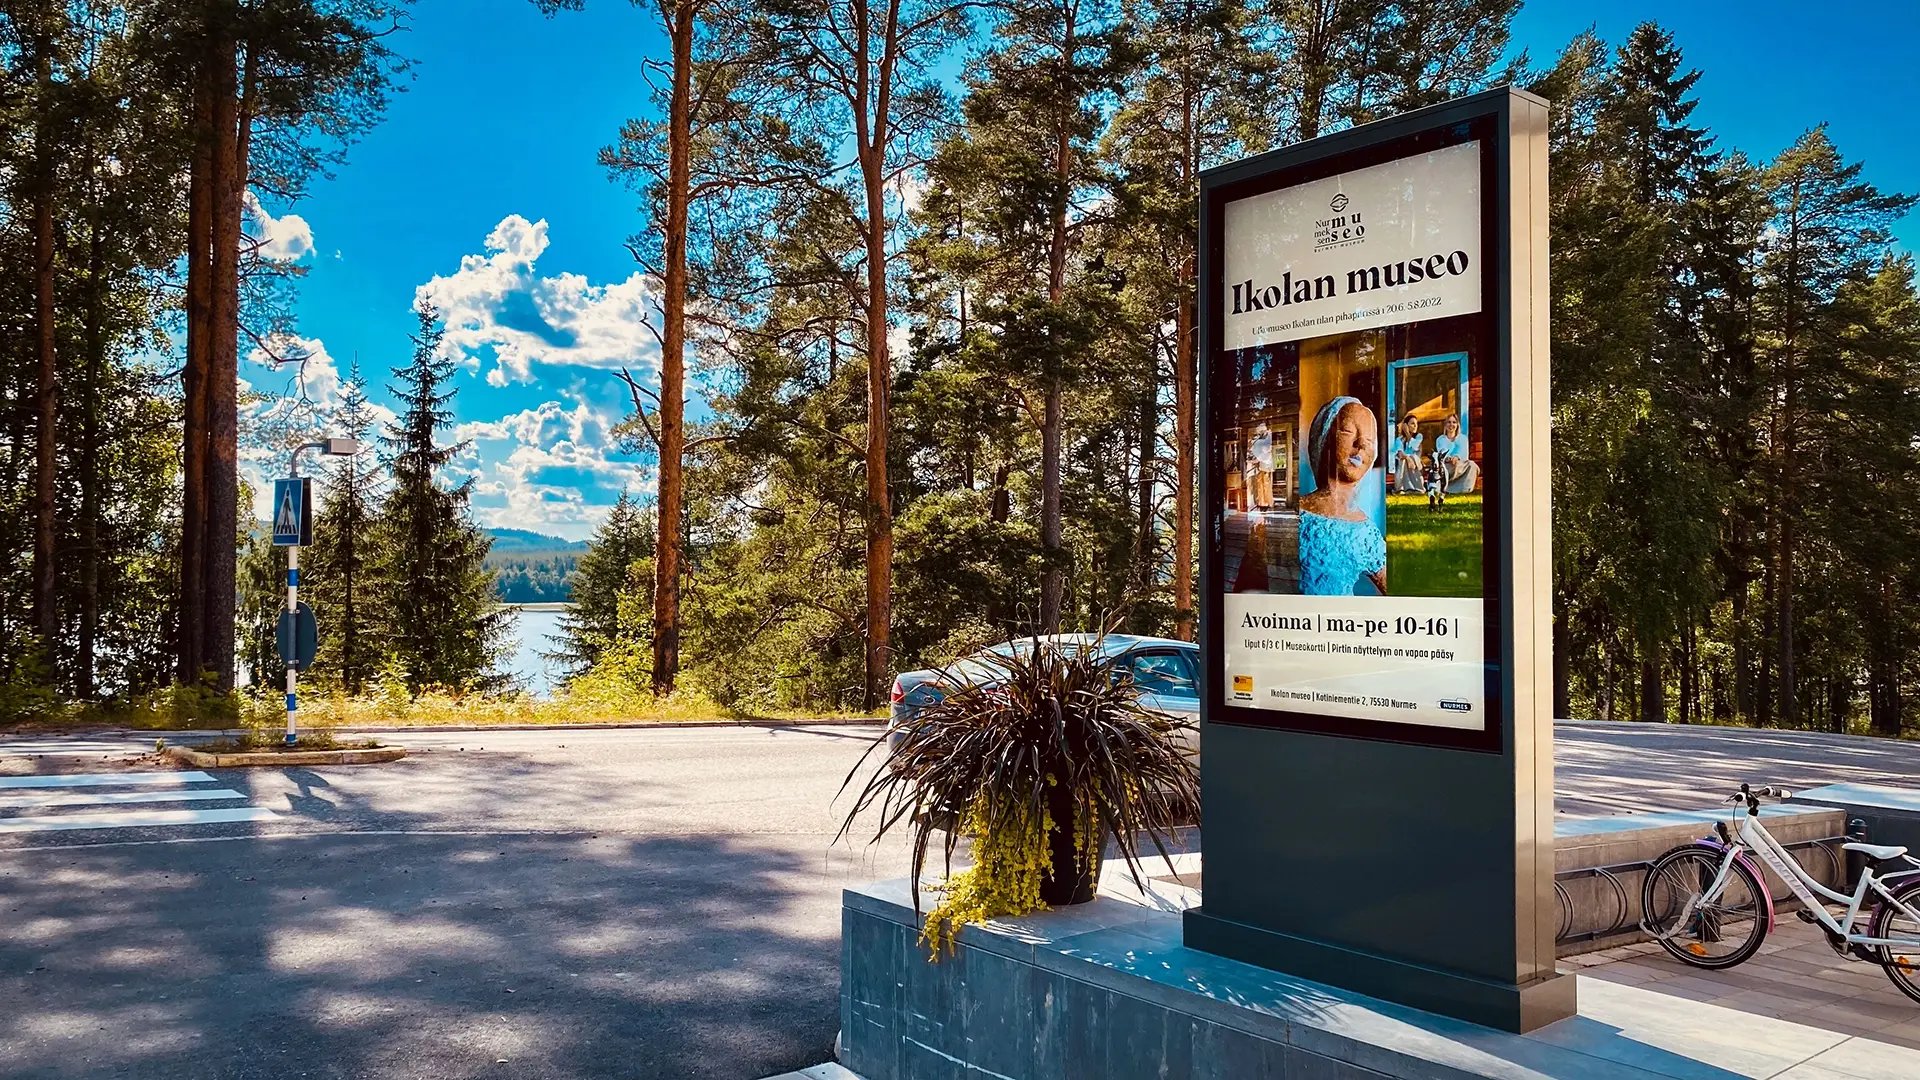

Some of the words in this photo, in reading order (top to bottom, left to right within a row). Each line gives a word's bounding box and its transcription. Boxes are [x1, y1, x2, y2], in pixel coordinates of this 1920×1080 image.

[1231, 272, 1337, 315] Ikolan
[1346, 250, 1470, 295] museo
[1292, 319, 1315, 329] Ikolan
[1316, 315, 1334, 325] tilan
[1241, 611, 1312, 631] Avoinna
[1326, 618, 1388, 637] ma-pe
[1394, 616, 1448, 636] 10-16
[1244, 639, 1260, 650] Liput
[1261, 639, 1273, 650] 6/3
[1285, 641, 1326, 652] Museokortti
[1331, 643, 1352, 654] Pirtin
[1353, 645, 1391, 658] näyttelyyn
[1393, 649, 1403, 657] on
[1405, 649, 1428, 659] vapaa
[1430, 649, 1454, 661] pääsy
[1270, 689, 1290, 699] Ikolan
[1291, 692, 1311, 701] museo
[1316, 692, 1360, 705] Kotiniementie
[1391, 699, 1417, 710] Nurmes
[1443, 702, 1469, 710] NURMES
